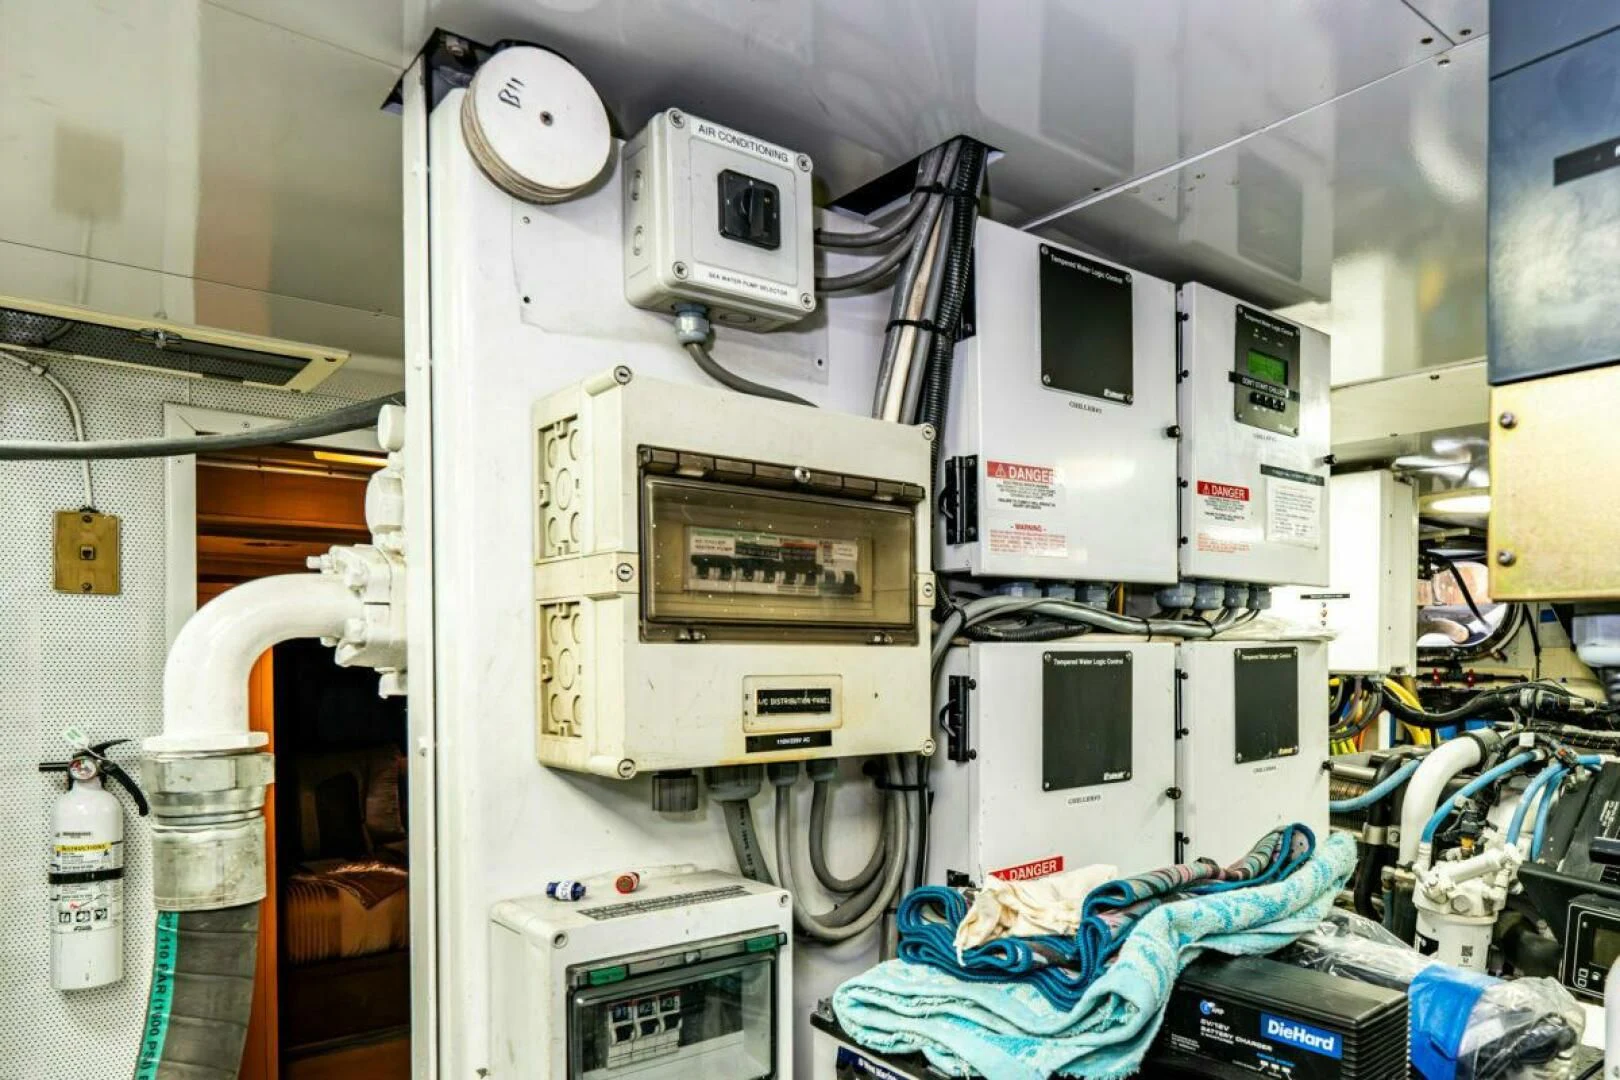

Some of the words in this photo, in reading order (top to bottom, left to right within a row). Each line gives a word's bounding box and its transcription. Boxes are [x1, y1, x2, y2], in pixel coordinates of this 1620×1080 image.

[698, 124, 716, 138] AIR
[718, 130, 788, 162] CONDITIONING
[1050, 253, 1077, 269] Tempered
[1076, 263, 1092, 274] Water
[1091, 266, 1106, 279] Logic
[721, 274, 742, 284] WATER
[742, 279, 758, 288] PUMP
[760, 284, 788, 296] SELECTOR
[1008, 466, 1055, 485] DANGER
[1211, 485, 1246, 499] DANGER
[1053, 658, 1078, 667] Tempered
[1093, 658, 1106, 667] Logic
[770, 697, 811, 706] DISTRIBUTION
[1009, 859, 1057, 881] DANGER
[158, 935, 170, 959] 110
[1200, 1025, 1235, 1040] BATTERY
[1235, 1035, 1273, 1052] CHARGER
[1267, 1018, 1335, 1053] DieHard
